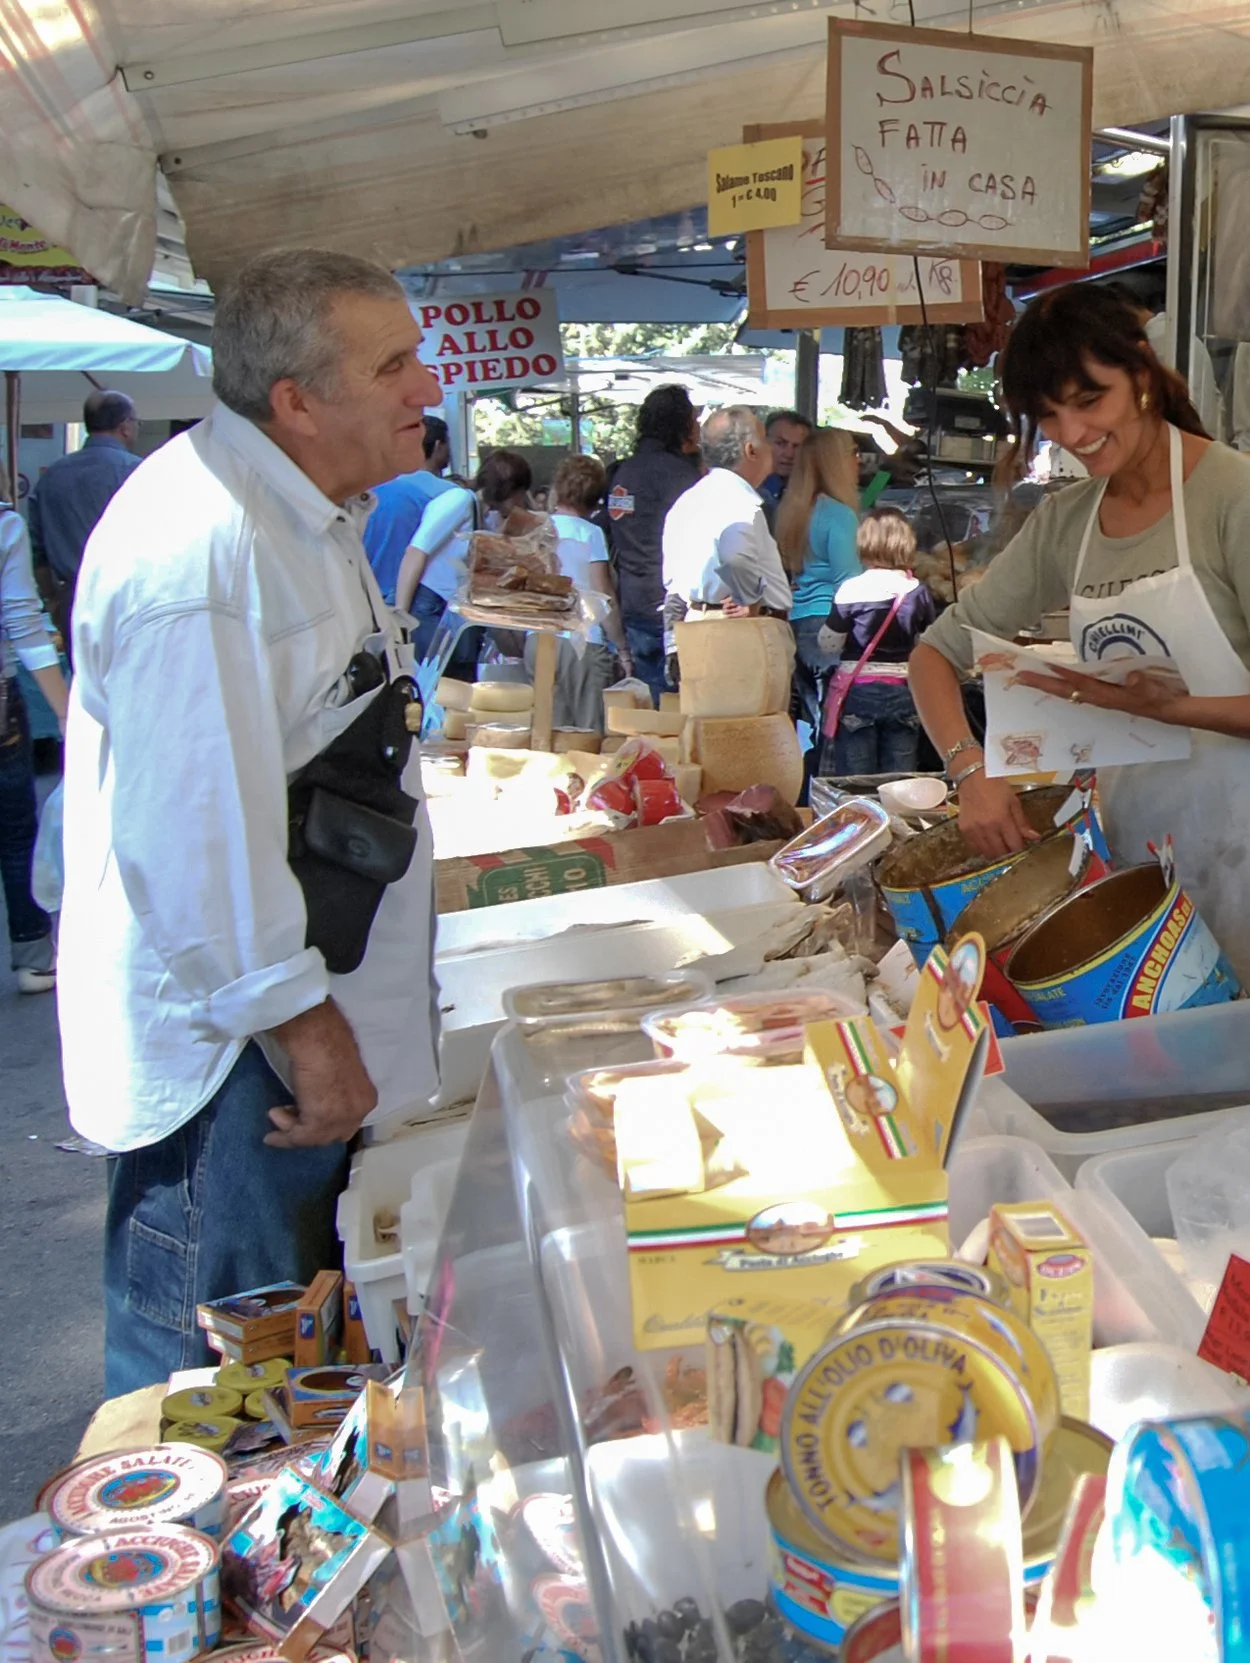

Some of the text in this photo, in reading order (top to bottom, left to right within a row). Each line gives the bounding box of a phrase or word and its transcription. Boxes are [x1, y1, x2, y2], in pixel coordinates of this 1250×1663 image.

[878, 119, 967, 153] FATTA
[715, 163, 794, 194] Salame Toscano
[968, 172, 1039, 206] CASA
[788, 270, 821, 304] €
[820, 262, 889, 300] 10,90
[419, 297, 542, 329] POLLO
[436, 327, 535, 357] ALLO
[1131, 907, 1187, 1010] ANCHOAS
[878, 1335, 969, 1376] D'OLIVA
[799, 1343, 875, 1426] ALL'OLIO
[795, 1433, 837, 1512] TONNO
